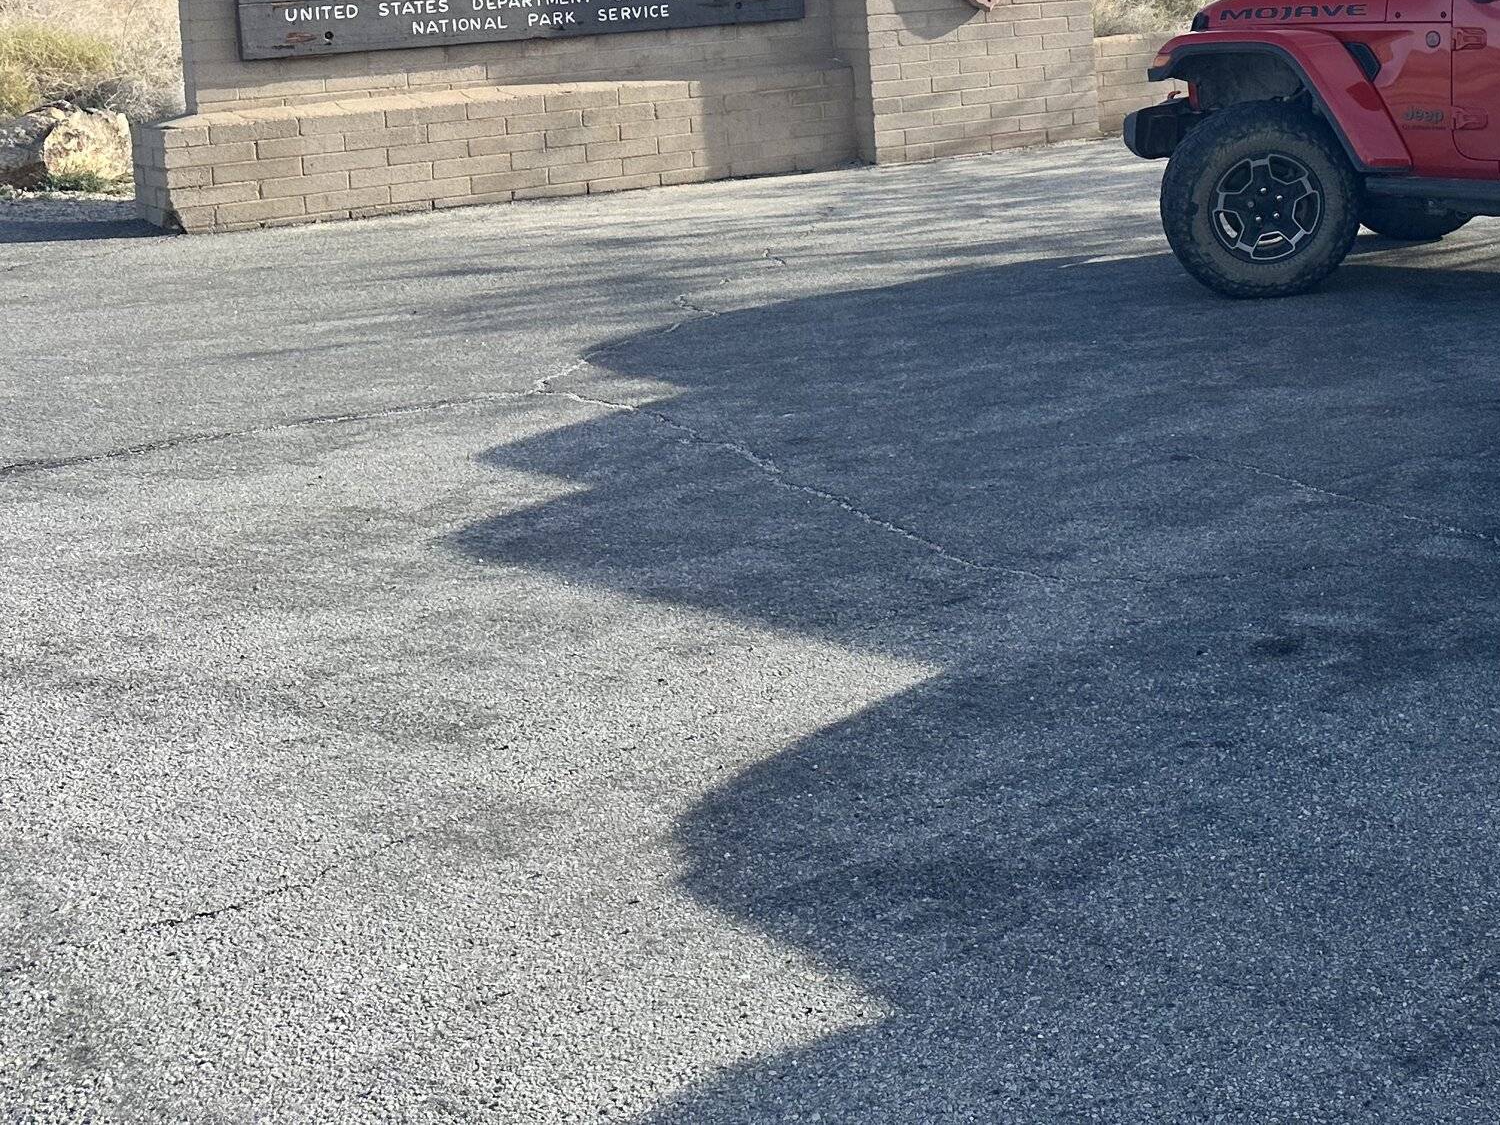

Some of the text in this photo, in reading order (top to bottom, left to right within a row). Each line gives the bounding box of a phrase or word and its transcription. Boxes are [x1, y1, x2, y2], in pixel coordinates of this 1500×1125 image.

[284, 4, 359, 22] UNITED
[378, 0, 449, 17] STATES
[412, 4, 670, 35] NATIONAL PARK SERVICE
[1220, 3, 1367, 21] MOJAVE
